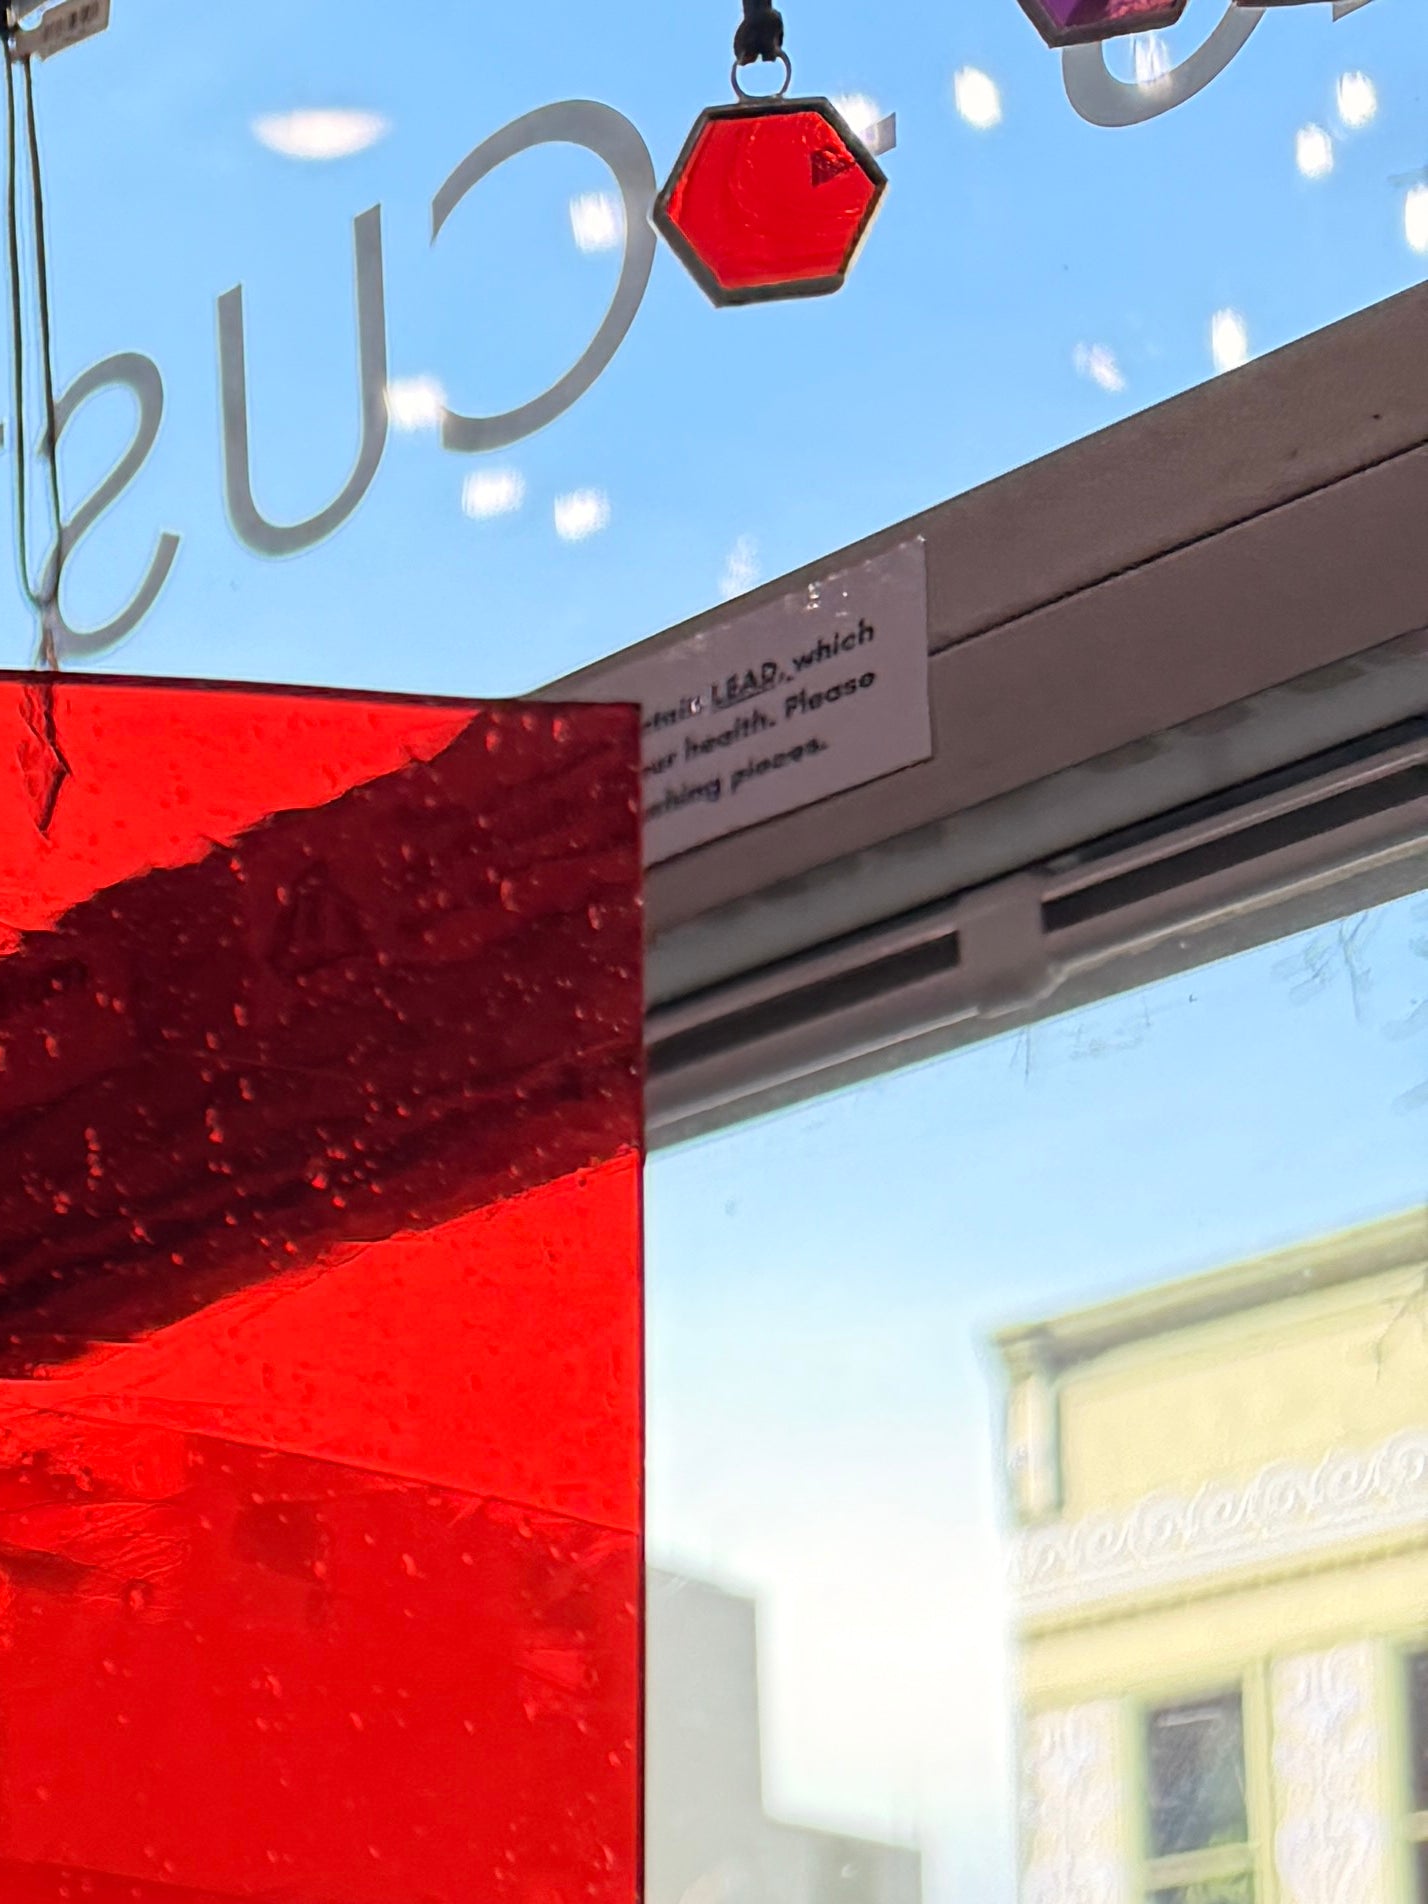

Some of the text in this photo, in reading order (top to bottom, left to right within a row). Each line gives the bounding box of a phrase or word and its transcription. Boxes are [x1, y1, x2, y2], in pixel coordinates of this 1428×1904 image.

[792, 618, 875, 672] which
[684, 708, 777, 763] health.
[784, 671, 876, 719] Please
